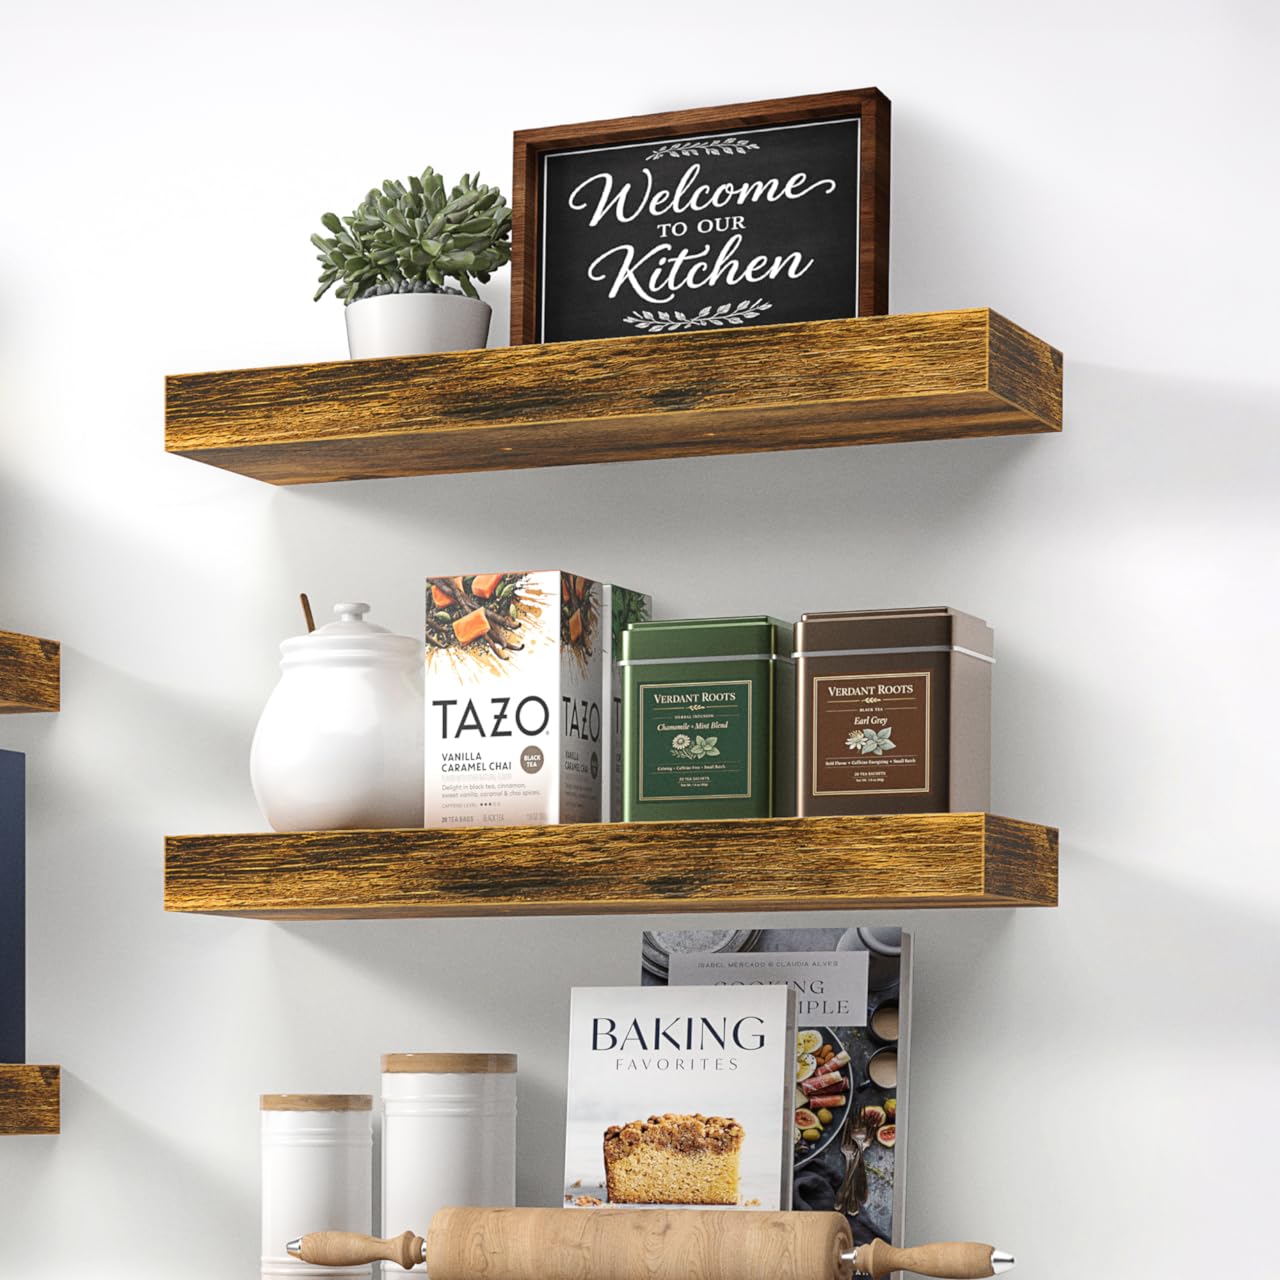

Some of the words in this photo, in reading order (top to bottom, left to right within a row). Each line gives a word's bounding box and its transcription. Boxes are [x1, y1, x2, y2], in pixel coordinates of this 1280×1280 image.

[568, 163, 837, 227] Welcome
[657, 222, 687, 238] TO
[697, 215, 746, 234] OUR
[588, 234, 815, 303] Kitchen
[828, 686, 875, 697] VERDANT
[878, 684, 914, 695] ROOTS
[654, 694, 700, 704] VERDANT
[701, 692, 736, 702] ROOTS
[432, 695, 549, 739] TAZO
[562, 696, 600, 742] TAZO
[854, 716, 870, 725] Earl
[871, 716, 888, 726] Grey
[441, 752, 482, 762] VANILLA
[441, 762, 487, 773] CARAMEL
[489, 761, 512, 771] CHAI
[776, 960, 809, 968] CLAUDIA
[591, 1016, 766, 1052] BAKING
[615, 1058, 739, 1071] FAVORITES
